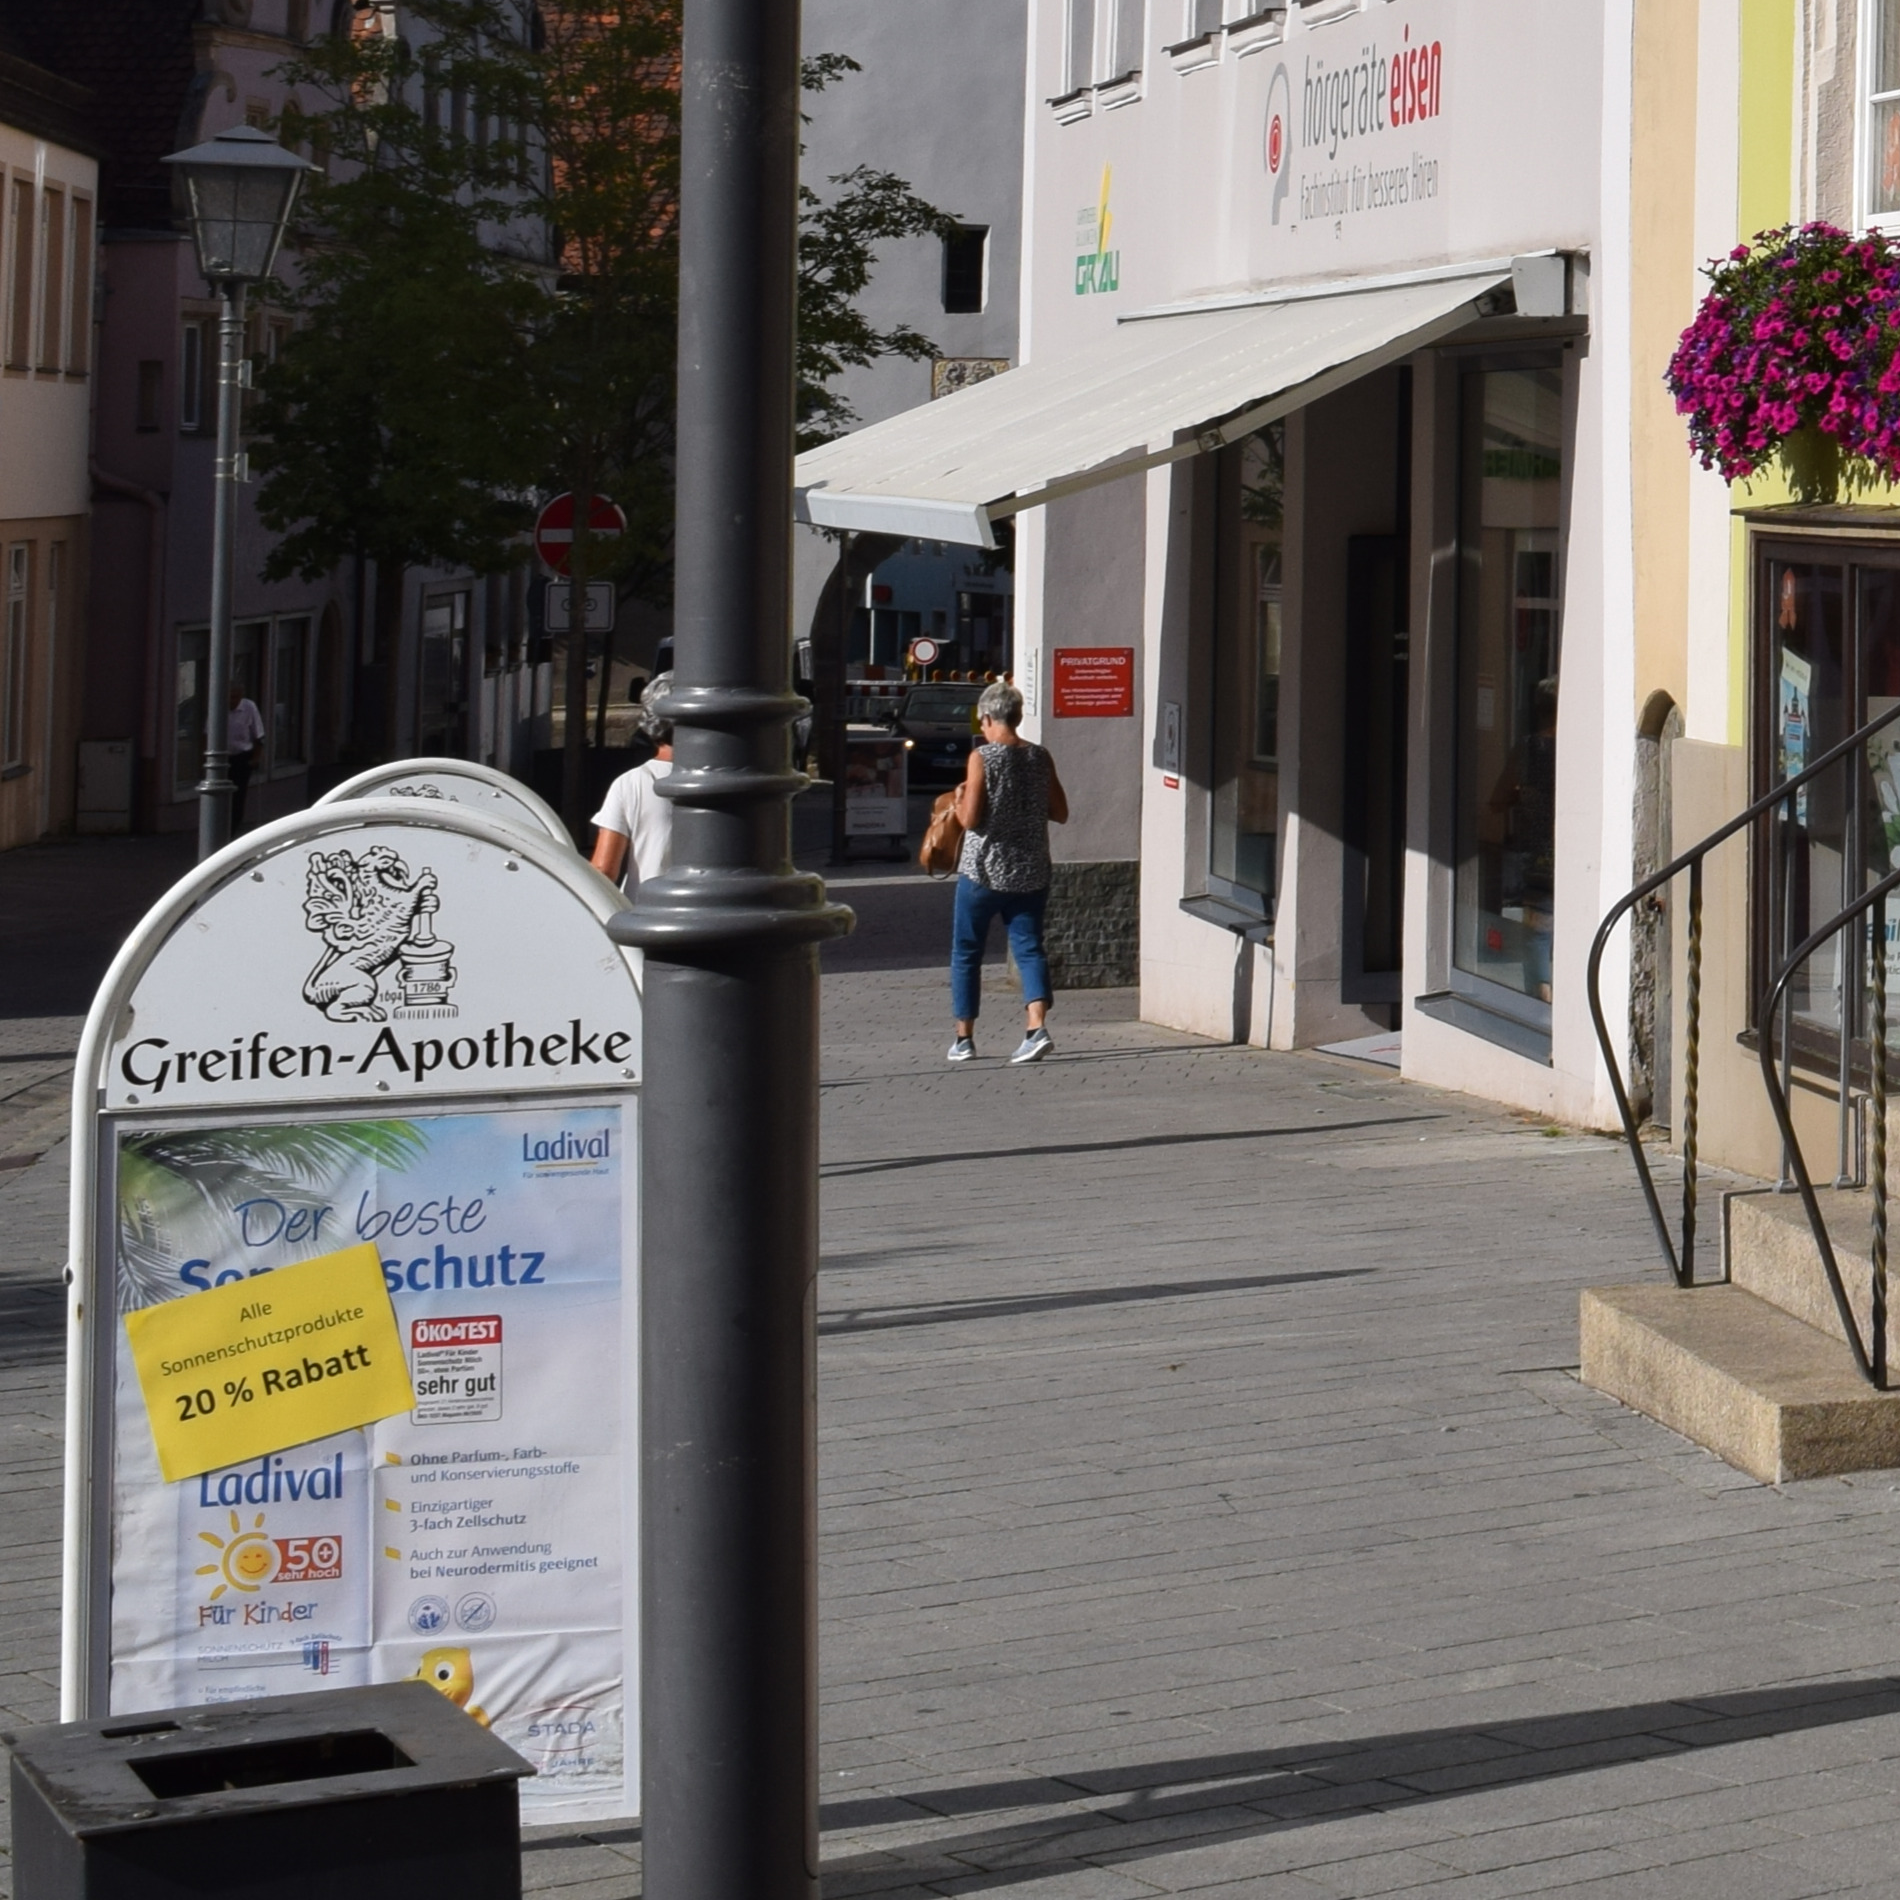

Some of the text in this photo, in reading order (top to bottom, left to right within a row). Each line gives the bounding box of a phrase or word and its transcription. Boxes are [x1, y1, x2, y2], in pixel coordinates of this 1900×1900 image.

[1301, 23, 1442, 161] hörgeräte eisen
[1299, 151, 1439, 221] Fachinstitut für besseres Hören
[1060, 656, 1127, 666] PRIVATGRUND
[379, 990, 403, 1004] 1694
[412, 982, 442, 993] 1786
[120, 1018, 634, 1094] Greifen-Apotheke
[523, 1128, 610, 1162] Ladival
[234, 1197, 333, 1247] Der
[238, 1301, 273, 1323] Alle
[160, 1304, 365, 1377] Sonnenschutzprodukte
[175, 1343, 372, 1422] 20 % Rabatt
[417, 1372, 496, 1398] sehr gut
[410, 1453, 448, 1466] Ohne
[512, 1446, 548, 1460] Farb-
[199, 1451, 344, 1508] Ladival
[410, 1461, 581, 1484] und Konservierungsstoffe
[410, 1498, 494, 1515] Einzigartiger
[409, 1513, 527, 1533] 3-fach Zellschutz
[410, 1541, 553, 1562] Auch zur Anwendung
[277, 1566, 340, 1582] sehr hoch
[409, 1556, 599, 1580] bei Neurodermitis geeignet
[199, 1600, 318, 1628] Für Kinder
[197, 1641, 284, 1654] SONNENSCHUTZ
[527, 1720, 596, 1738] STADA
